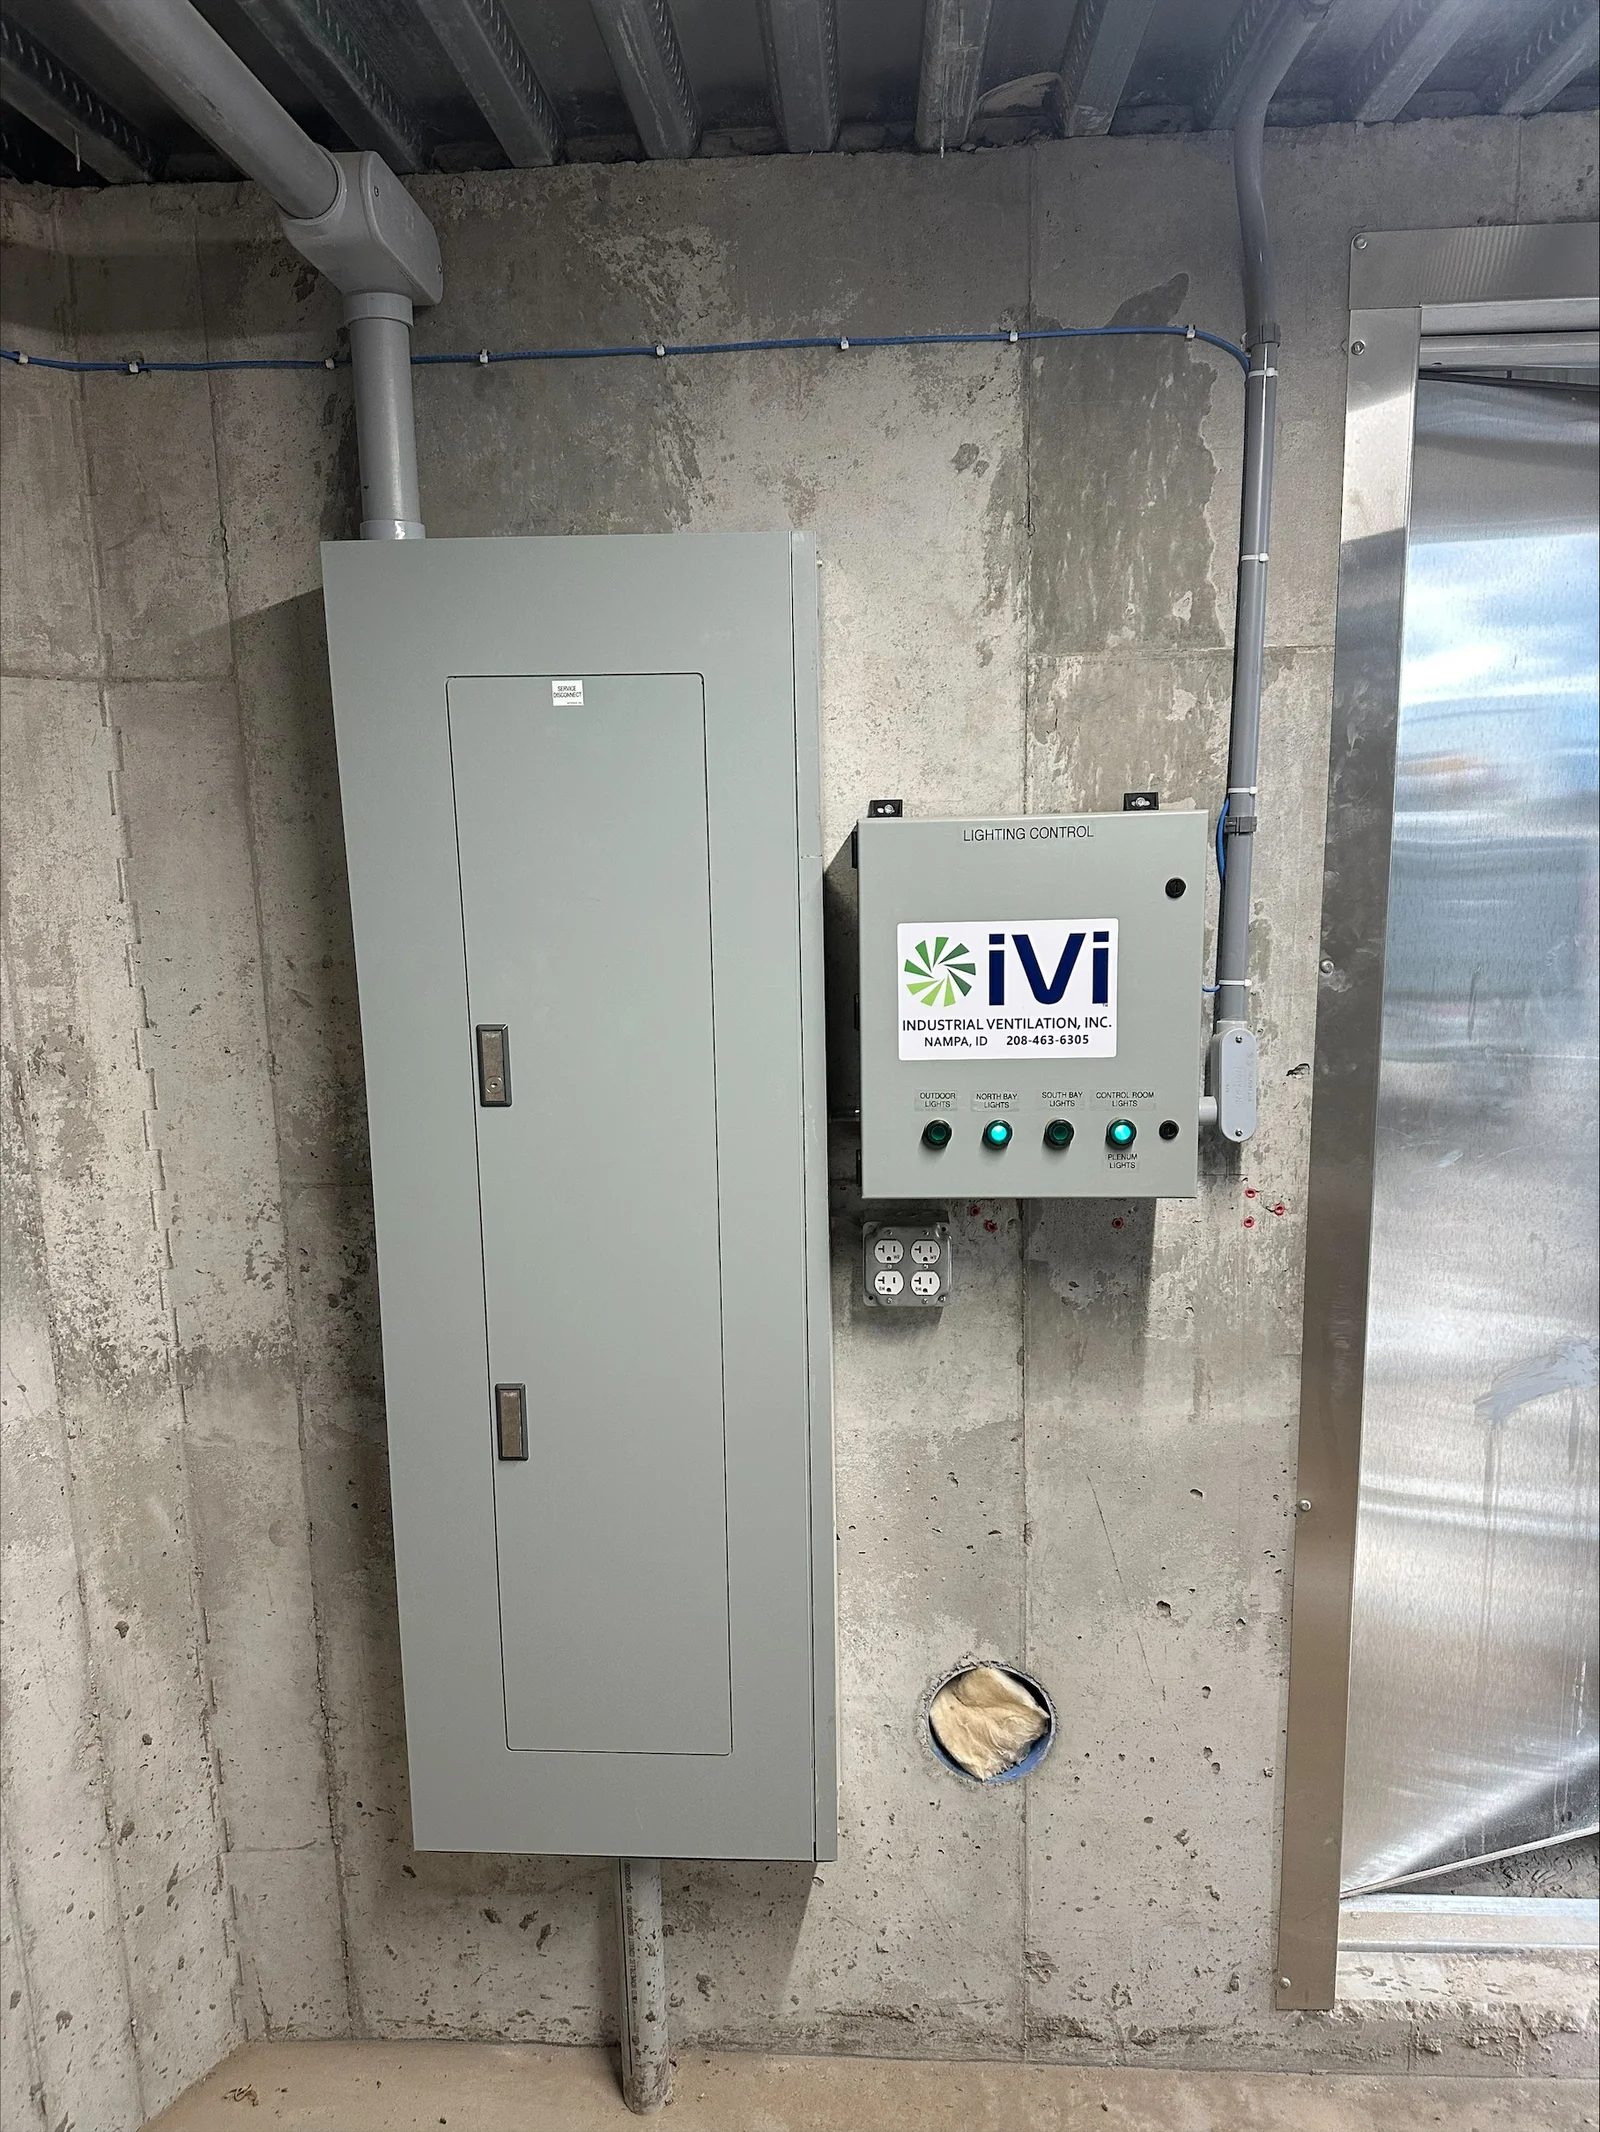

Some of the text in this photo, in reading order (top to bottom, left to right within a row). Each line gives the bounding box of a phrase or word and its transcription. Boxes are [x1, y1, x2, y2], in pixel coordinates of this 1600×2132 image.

[963, 824, 1094, 842] LIGHTING CONTROL
[902, 1015, 1112, 1032] INDUSTRIAL VENTILATION, INC.
[924, 1034, 1089, 1048] NAMPA, ID 208-463-6305
[919, 1092, 956, 1100] OUTDOOR
[1041, 1091, 1083, 1099] SOUTH BAY
[1095, 1091, 1155, 1099] CONTROL ROOM
[925, 1100, 951, 1108] LIGHTS
[1049, 1099, 1075, 1107] LIGHTS
[1112, 1099, 1138, 1107] LIGHTS
[1107, 1153, 1138, 1161] PLENUM
[1109, 1161, 1136, 1169] LIGHTS
